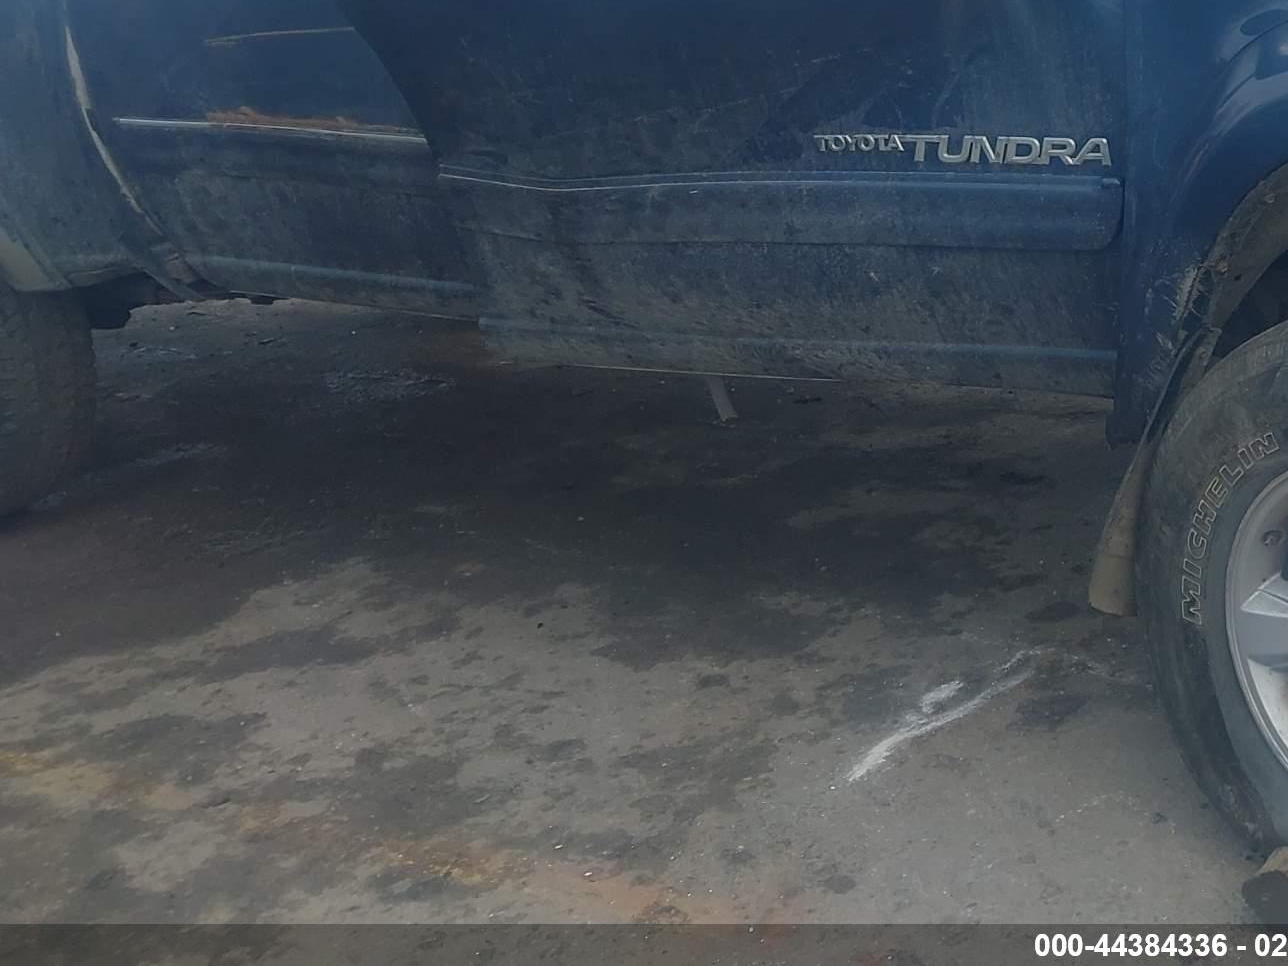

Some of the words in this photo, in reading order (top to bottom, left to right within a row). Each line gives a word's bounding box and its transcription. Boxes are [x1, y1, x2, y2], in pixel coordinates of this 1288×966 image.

[813, 134, 904, 152] TOYOTA
[901, 134, 1112, 167] TUNDRA
[1181, 432, 1280, 625] MICHELIN
